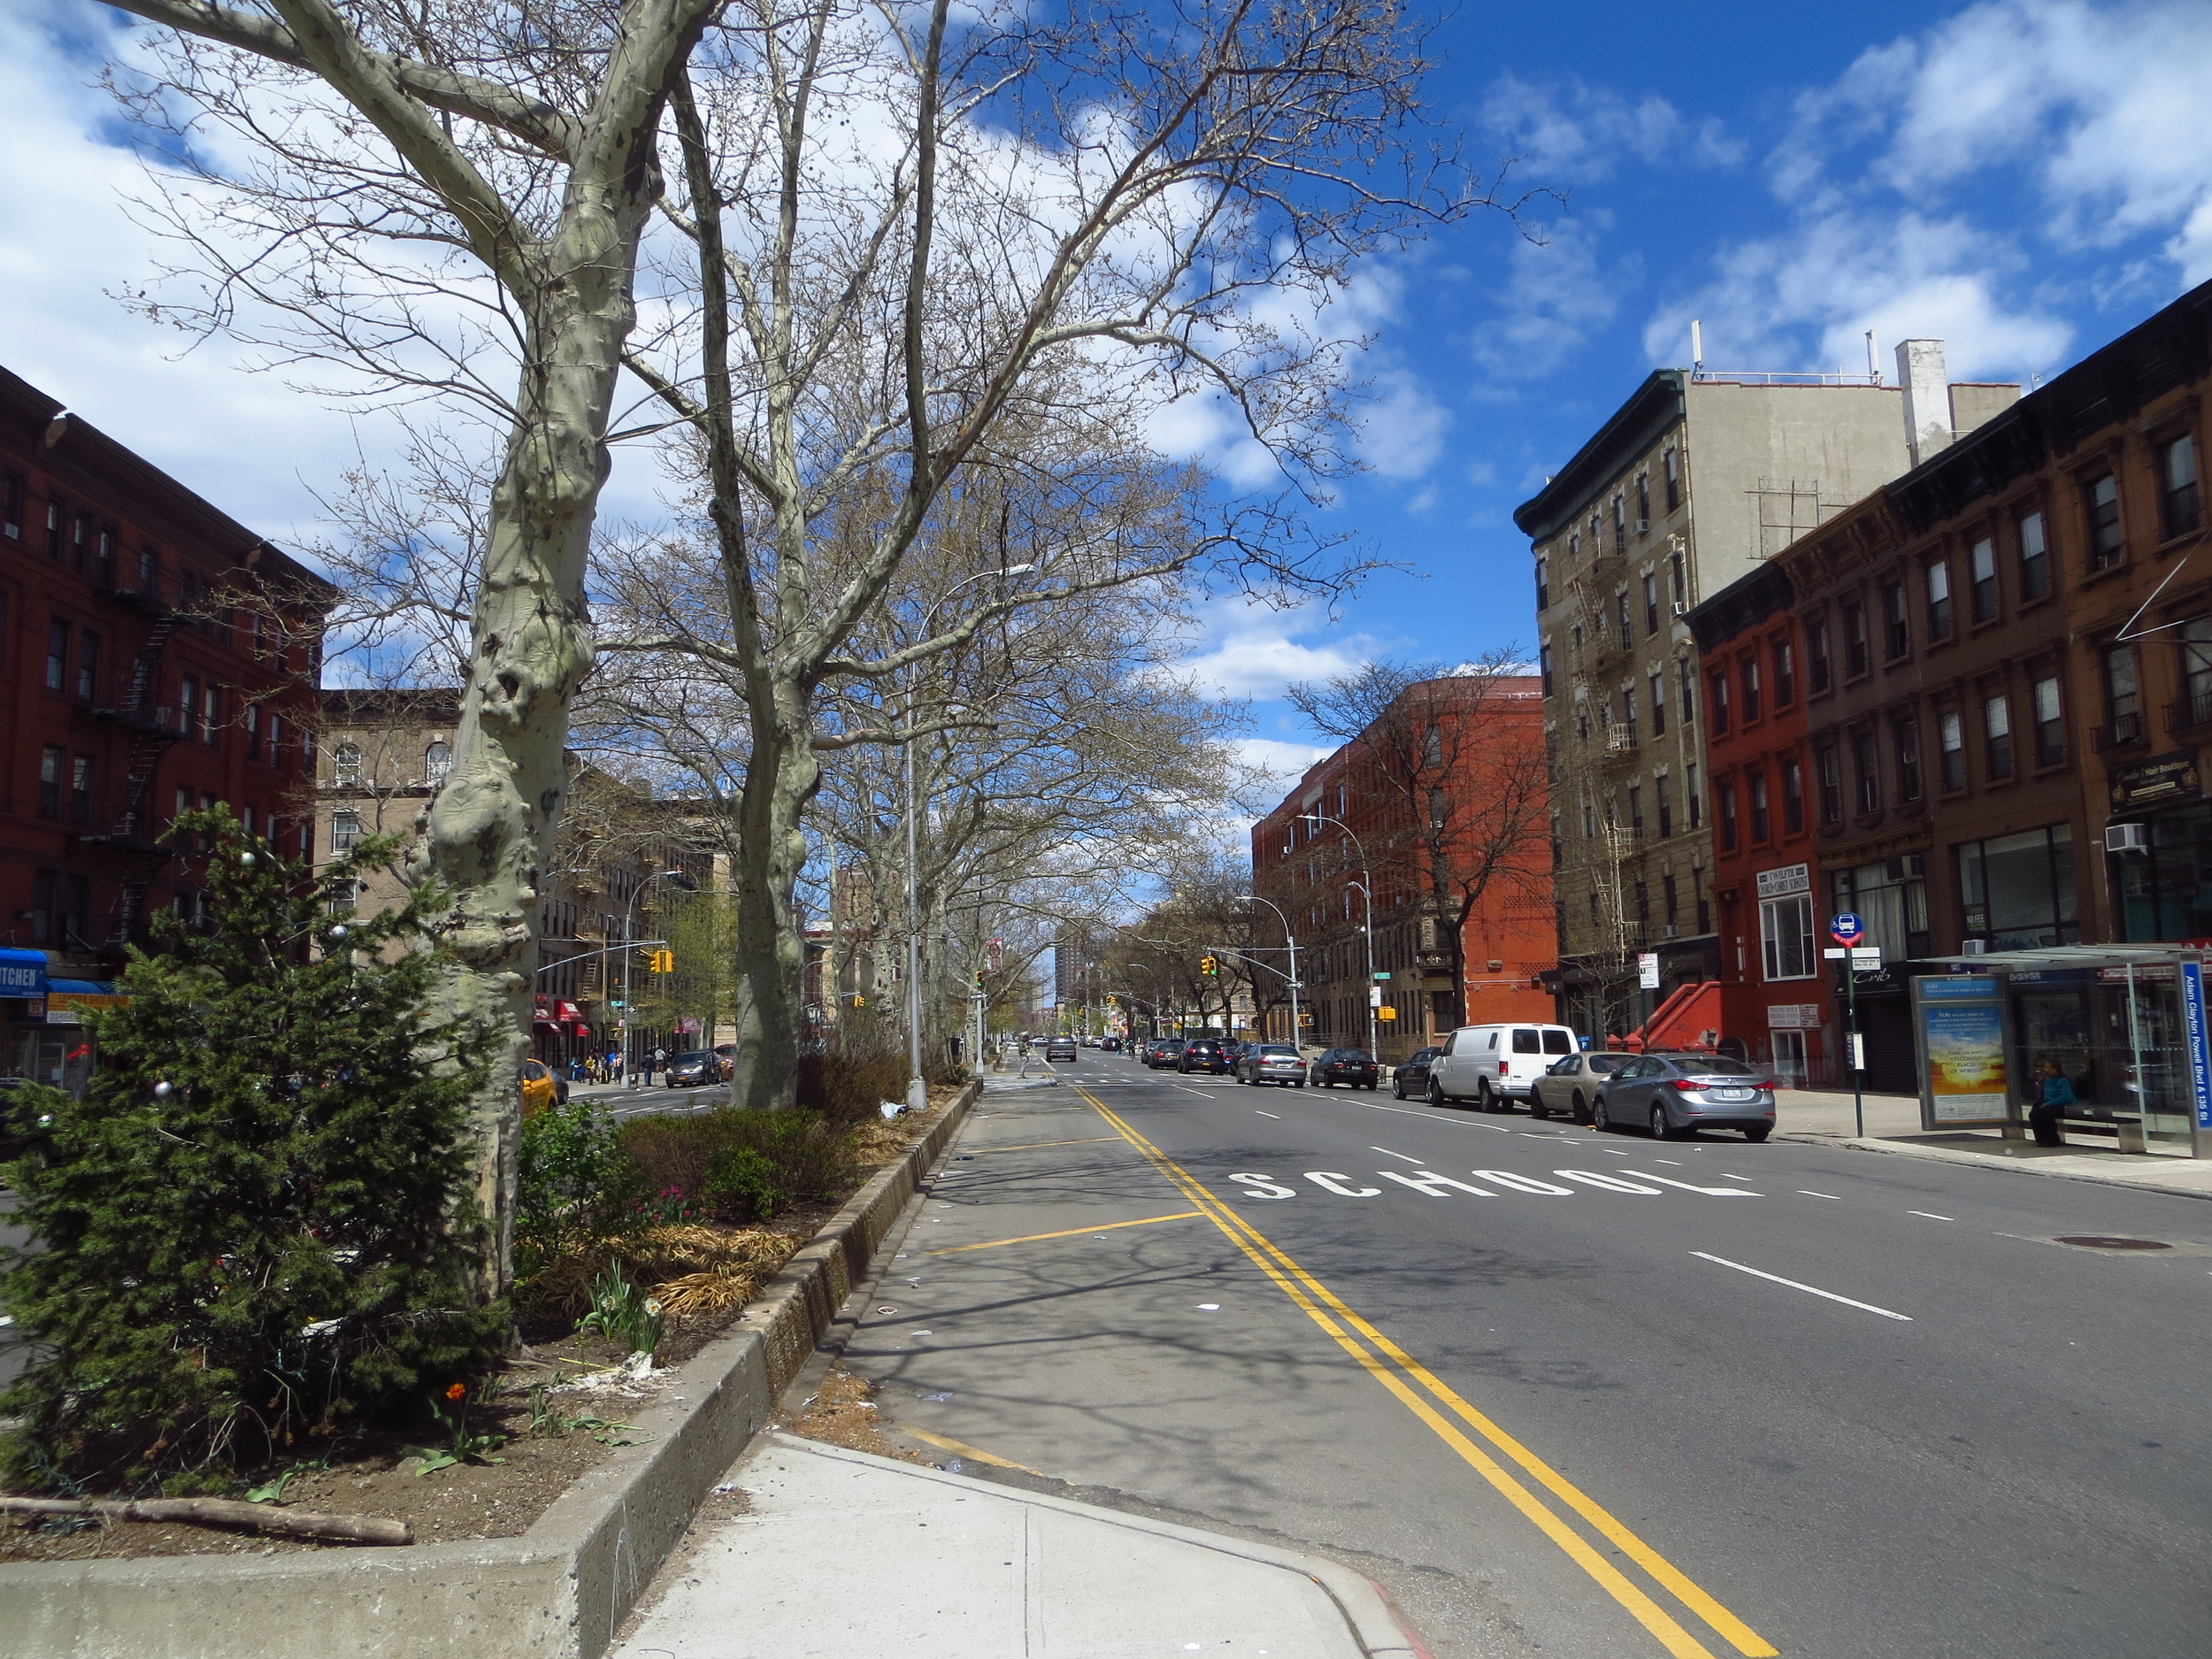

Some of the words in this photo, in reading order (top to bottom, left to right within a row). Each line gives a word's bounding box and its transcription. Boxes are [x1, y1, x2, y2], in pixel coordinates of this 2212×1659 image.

[1769, 868, 1795, 881] TWELFTH
[1974, 913, 1985, 923] FEE
[1853, 968, 1891, 983] Crib
[2185, 975, 2195, 1001] Adam
[2188, 1002, 2199, 1034] Clayton
[2192, 1036, 2201, 1064] Powell
[2194, 1065, 2204, 1085] Blvd
[2198, 1095, 2207, 1110] 135
[2200, 1110, 2208, 1121] St
[1227, 1169, 1765, 1200] SCHOOL
